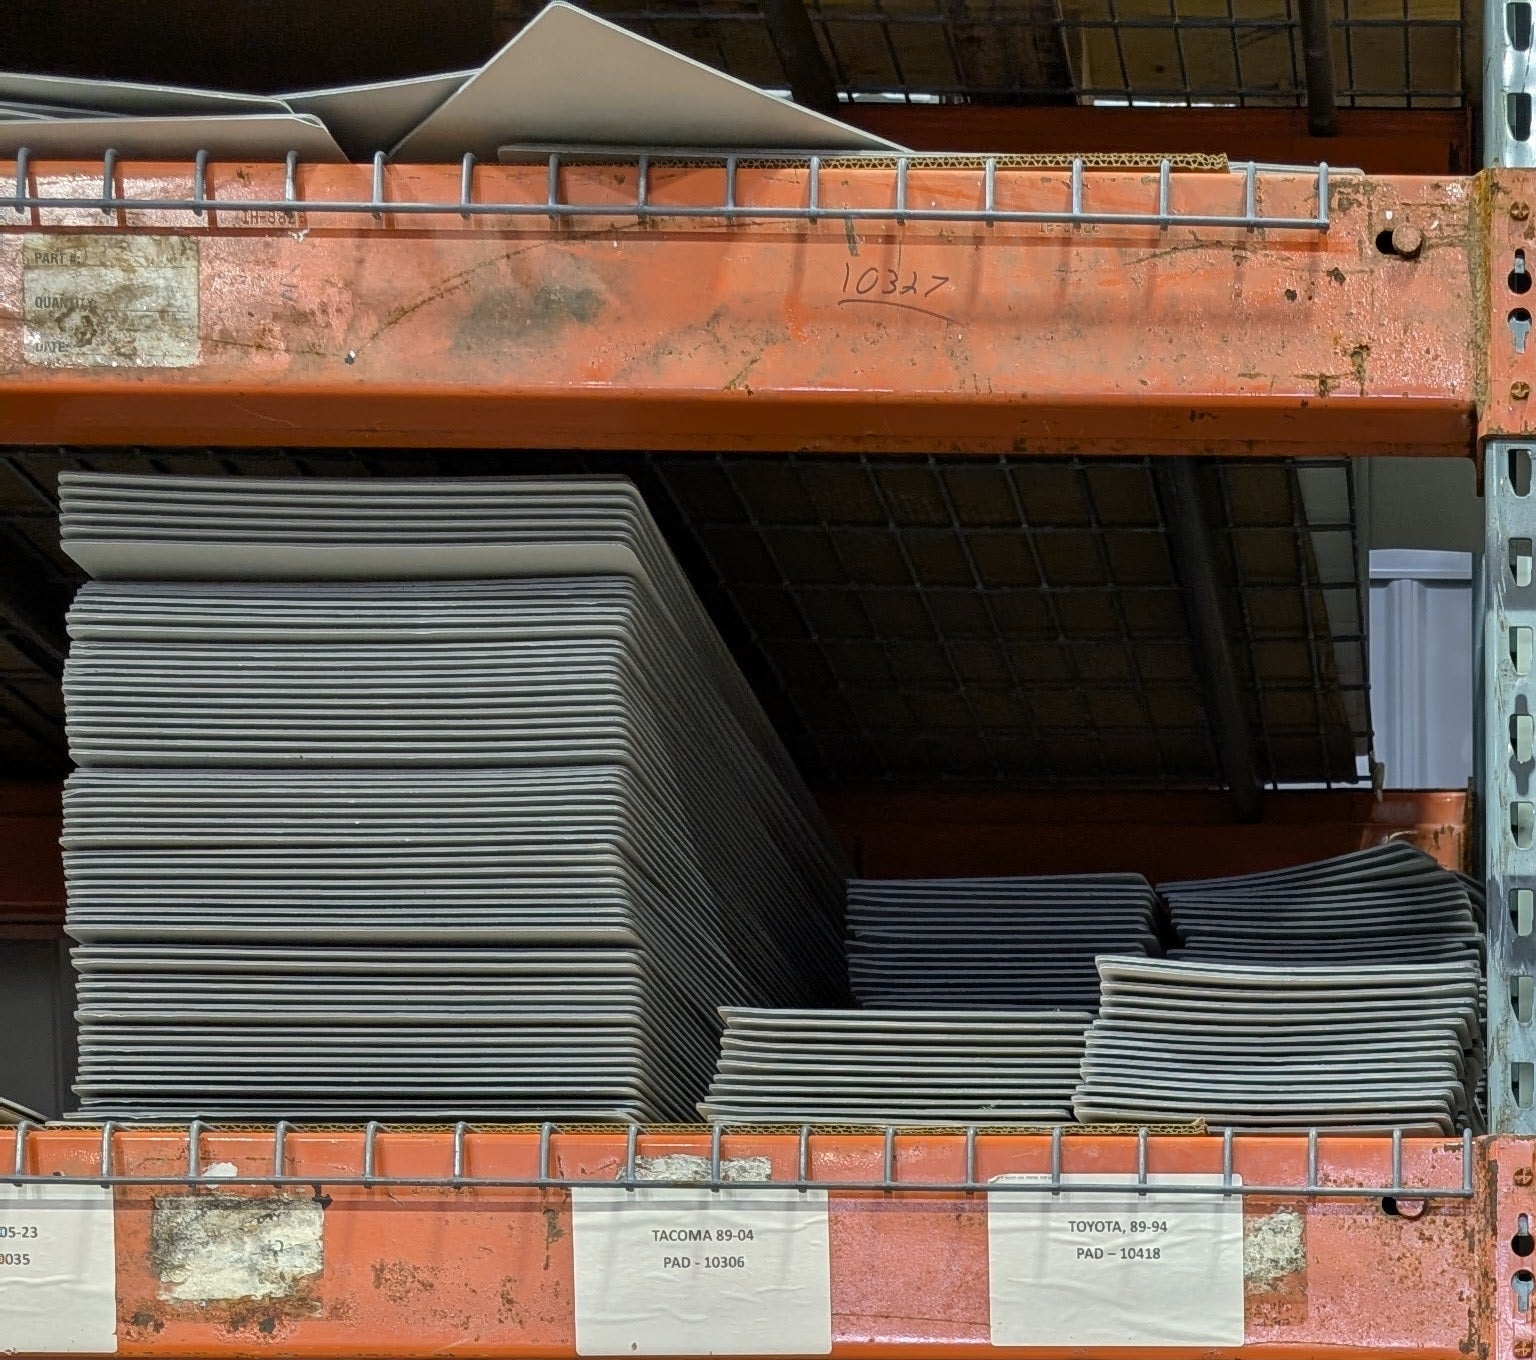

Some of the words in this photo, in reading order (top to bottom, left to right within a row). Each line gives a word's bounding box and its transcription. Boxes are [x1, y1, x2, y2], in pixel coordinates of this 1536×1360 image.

[35, 252, 66, 265] PART
[843, 262, 950, 298] 10327
[1067, 1220, 1127, 1235] TOYOTA,
[1129, 1220, 1168, 1233] 89-94
[651, 1229, 713, 1242] TACOMA
[716, 1229, 755, 1242] 89-04
[1076, 1247, 1104, 1260] PAD
[1120, 1247, 1161, 1260] 10418
[663, 1256, 691, 1269] PAD
[704, 1256, 745, 1269] 10306
